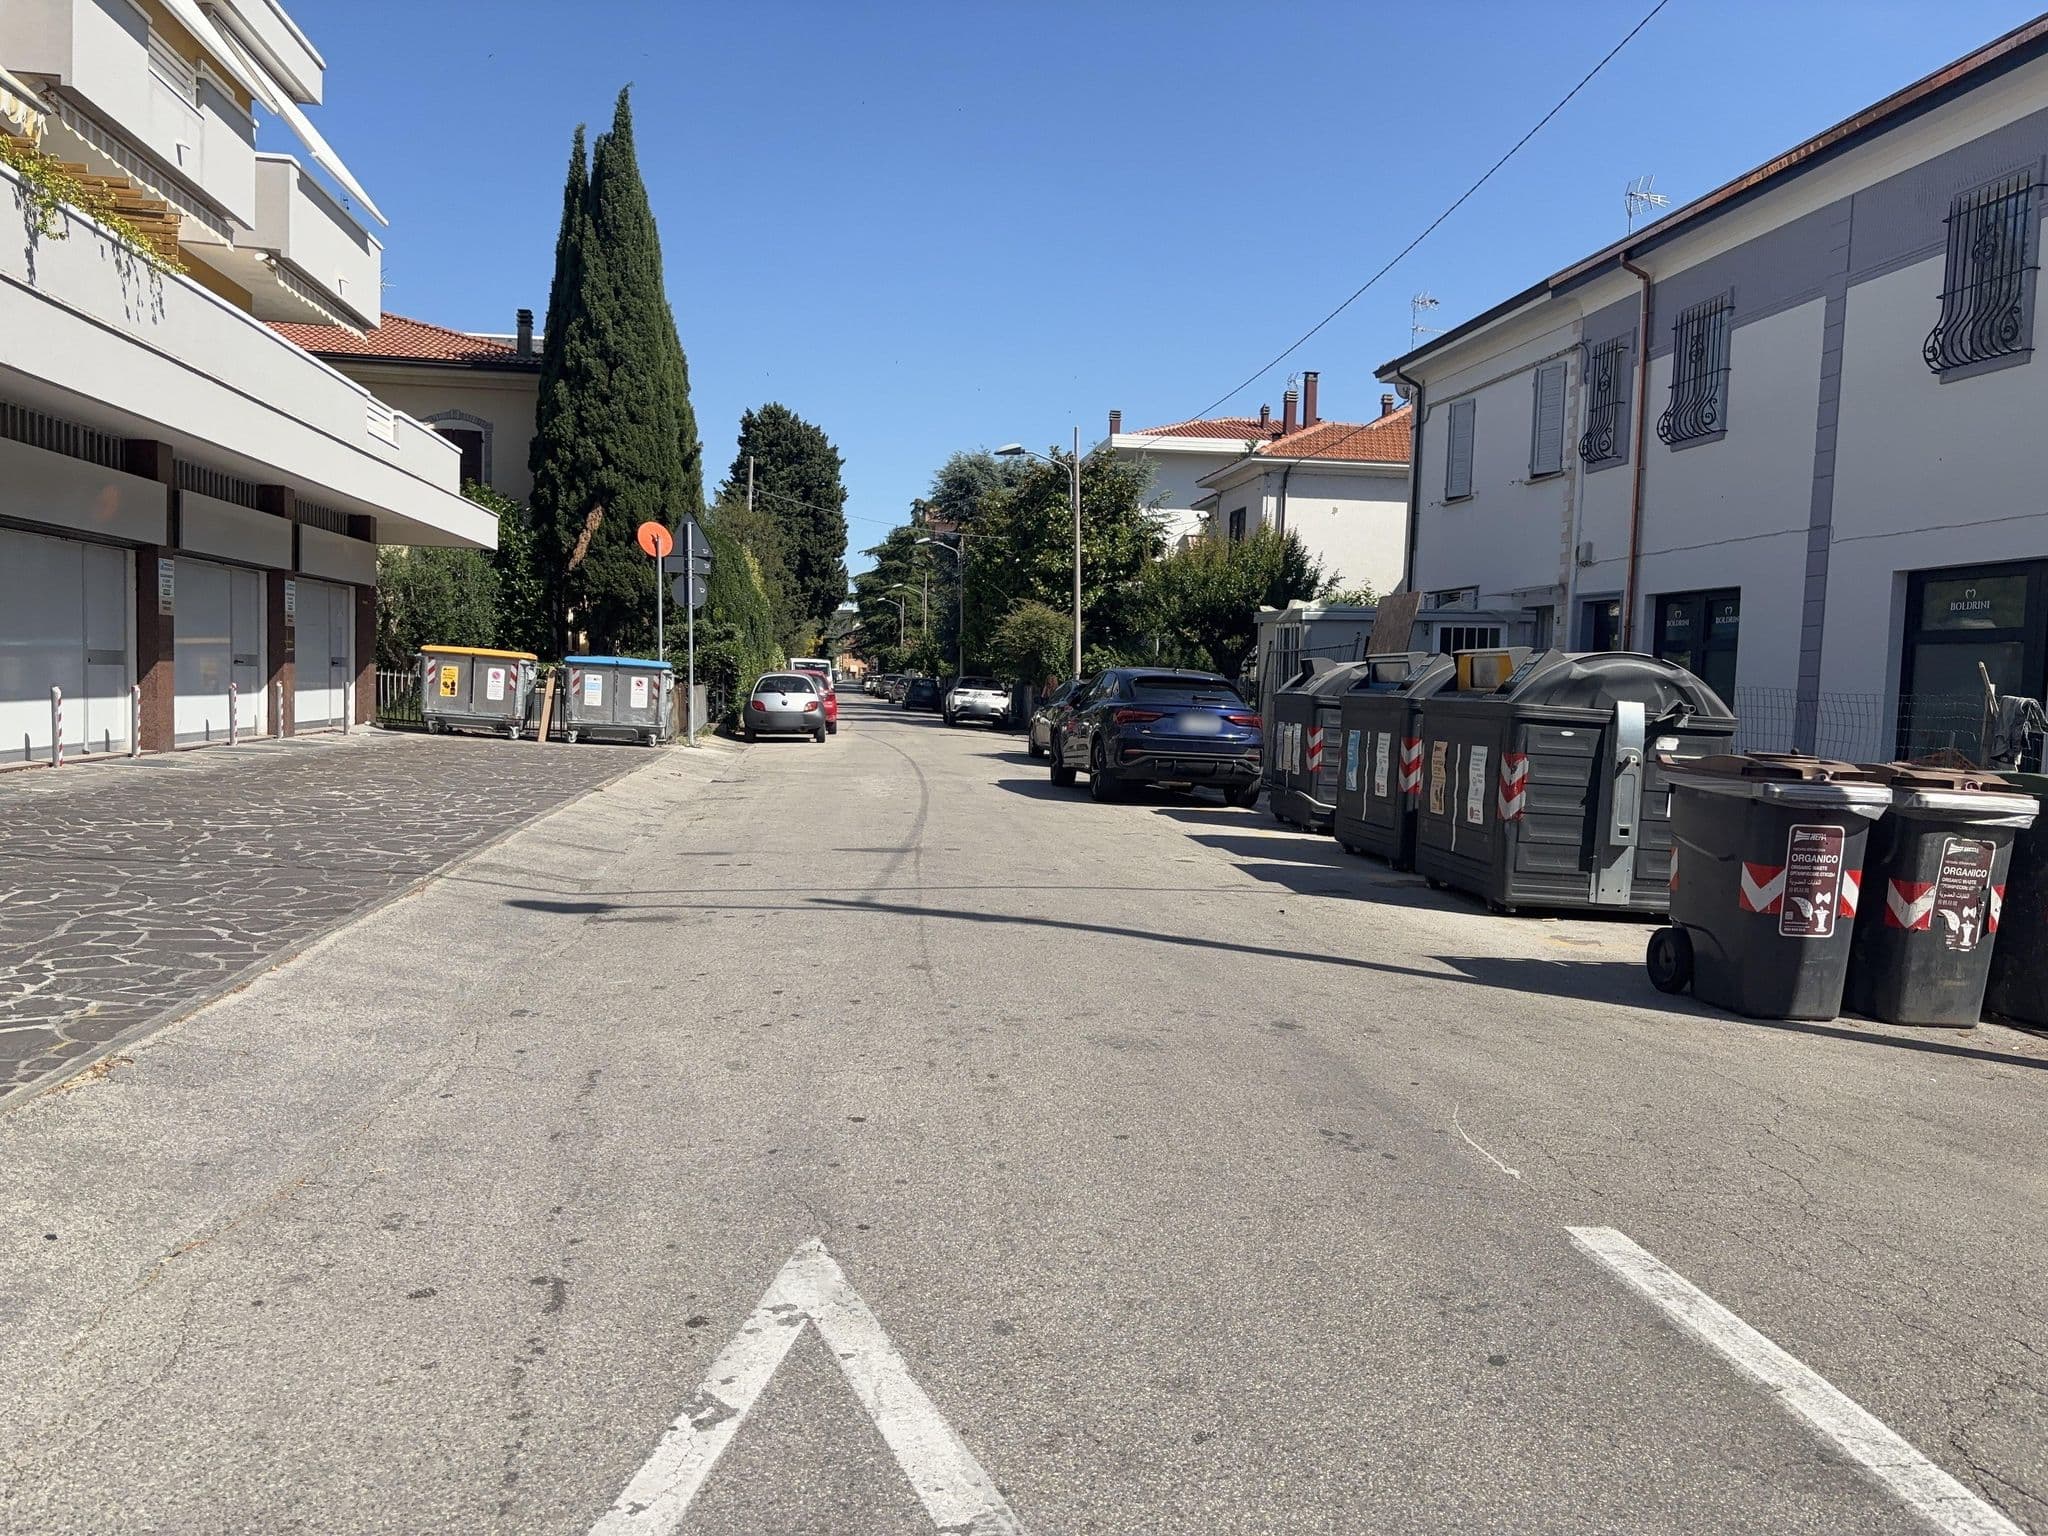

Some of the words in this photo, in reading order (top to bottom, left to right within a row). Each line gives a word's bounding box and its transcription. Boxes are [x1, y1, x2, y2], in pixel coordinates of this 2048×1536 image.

[1950, 600, 1990, 610] BOLDRINI
[1791, 853, 1839, 864] ORGANICO
[1943, 866, 1987, 878] ORGANICO
